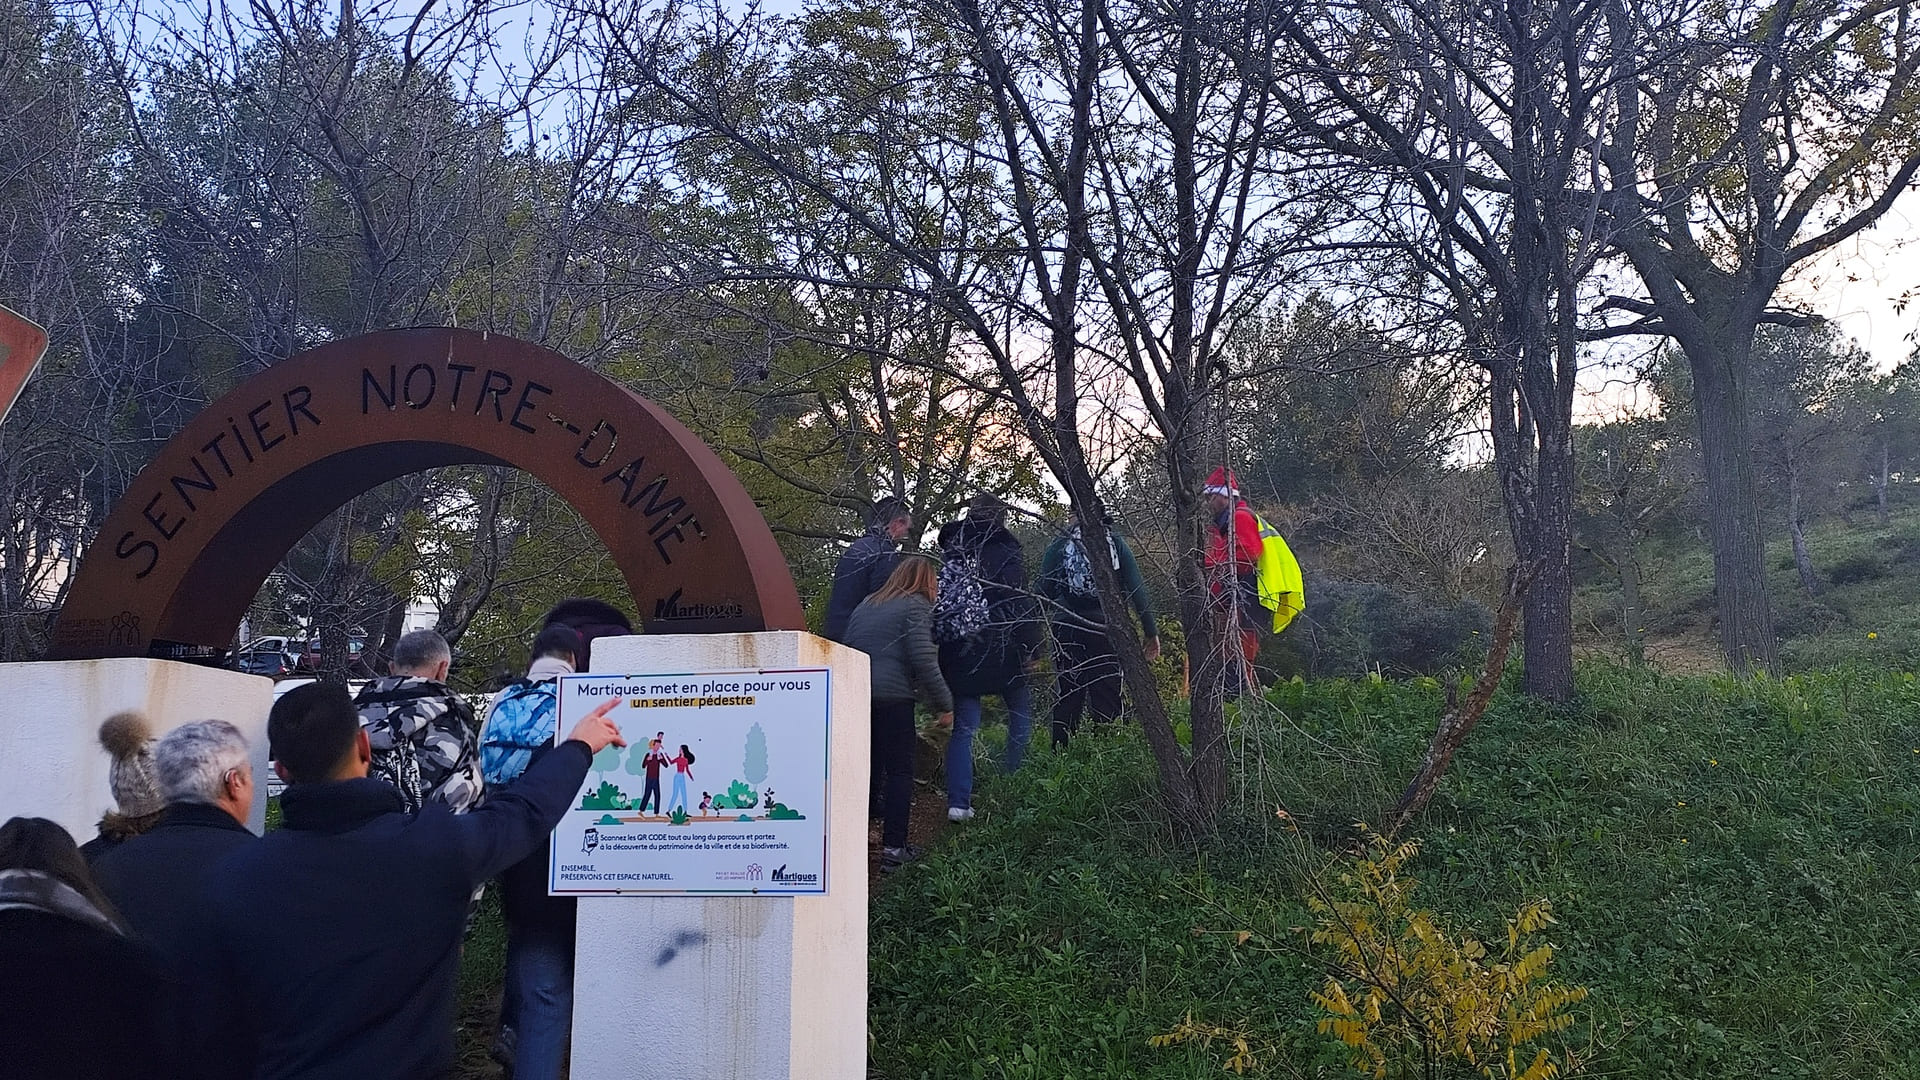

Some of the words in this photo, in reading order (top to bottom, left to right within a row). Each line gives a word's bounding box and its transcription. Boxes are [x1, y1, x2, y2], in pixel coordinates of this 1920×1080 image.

[116, 385, 321, 579] SENTIER
[578, 683, 646, 697] Martigues
[651, 683, 678, 694] met
[682, 684, 698, 693] en
[703, 681, 739, 696] place
[744, 681, 775, 695] pour
[779, 681, 810, 691] vous
[633, 698, 648, 707] un
[652, 697, 695, 707] sentier
[699, 695, 753, 709] pédestre
[659, 843, 693, 851] patrimoine
[772, 864, 816, 882] Martigues
